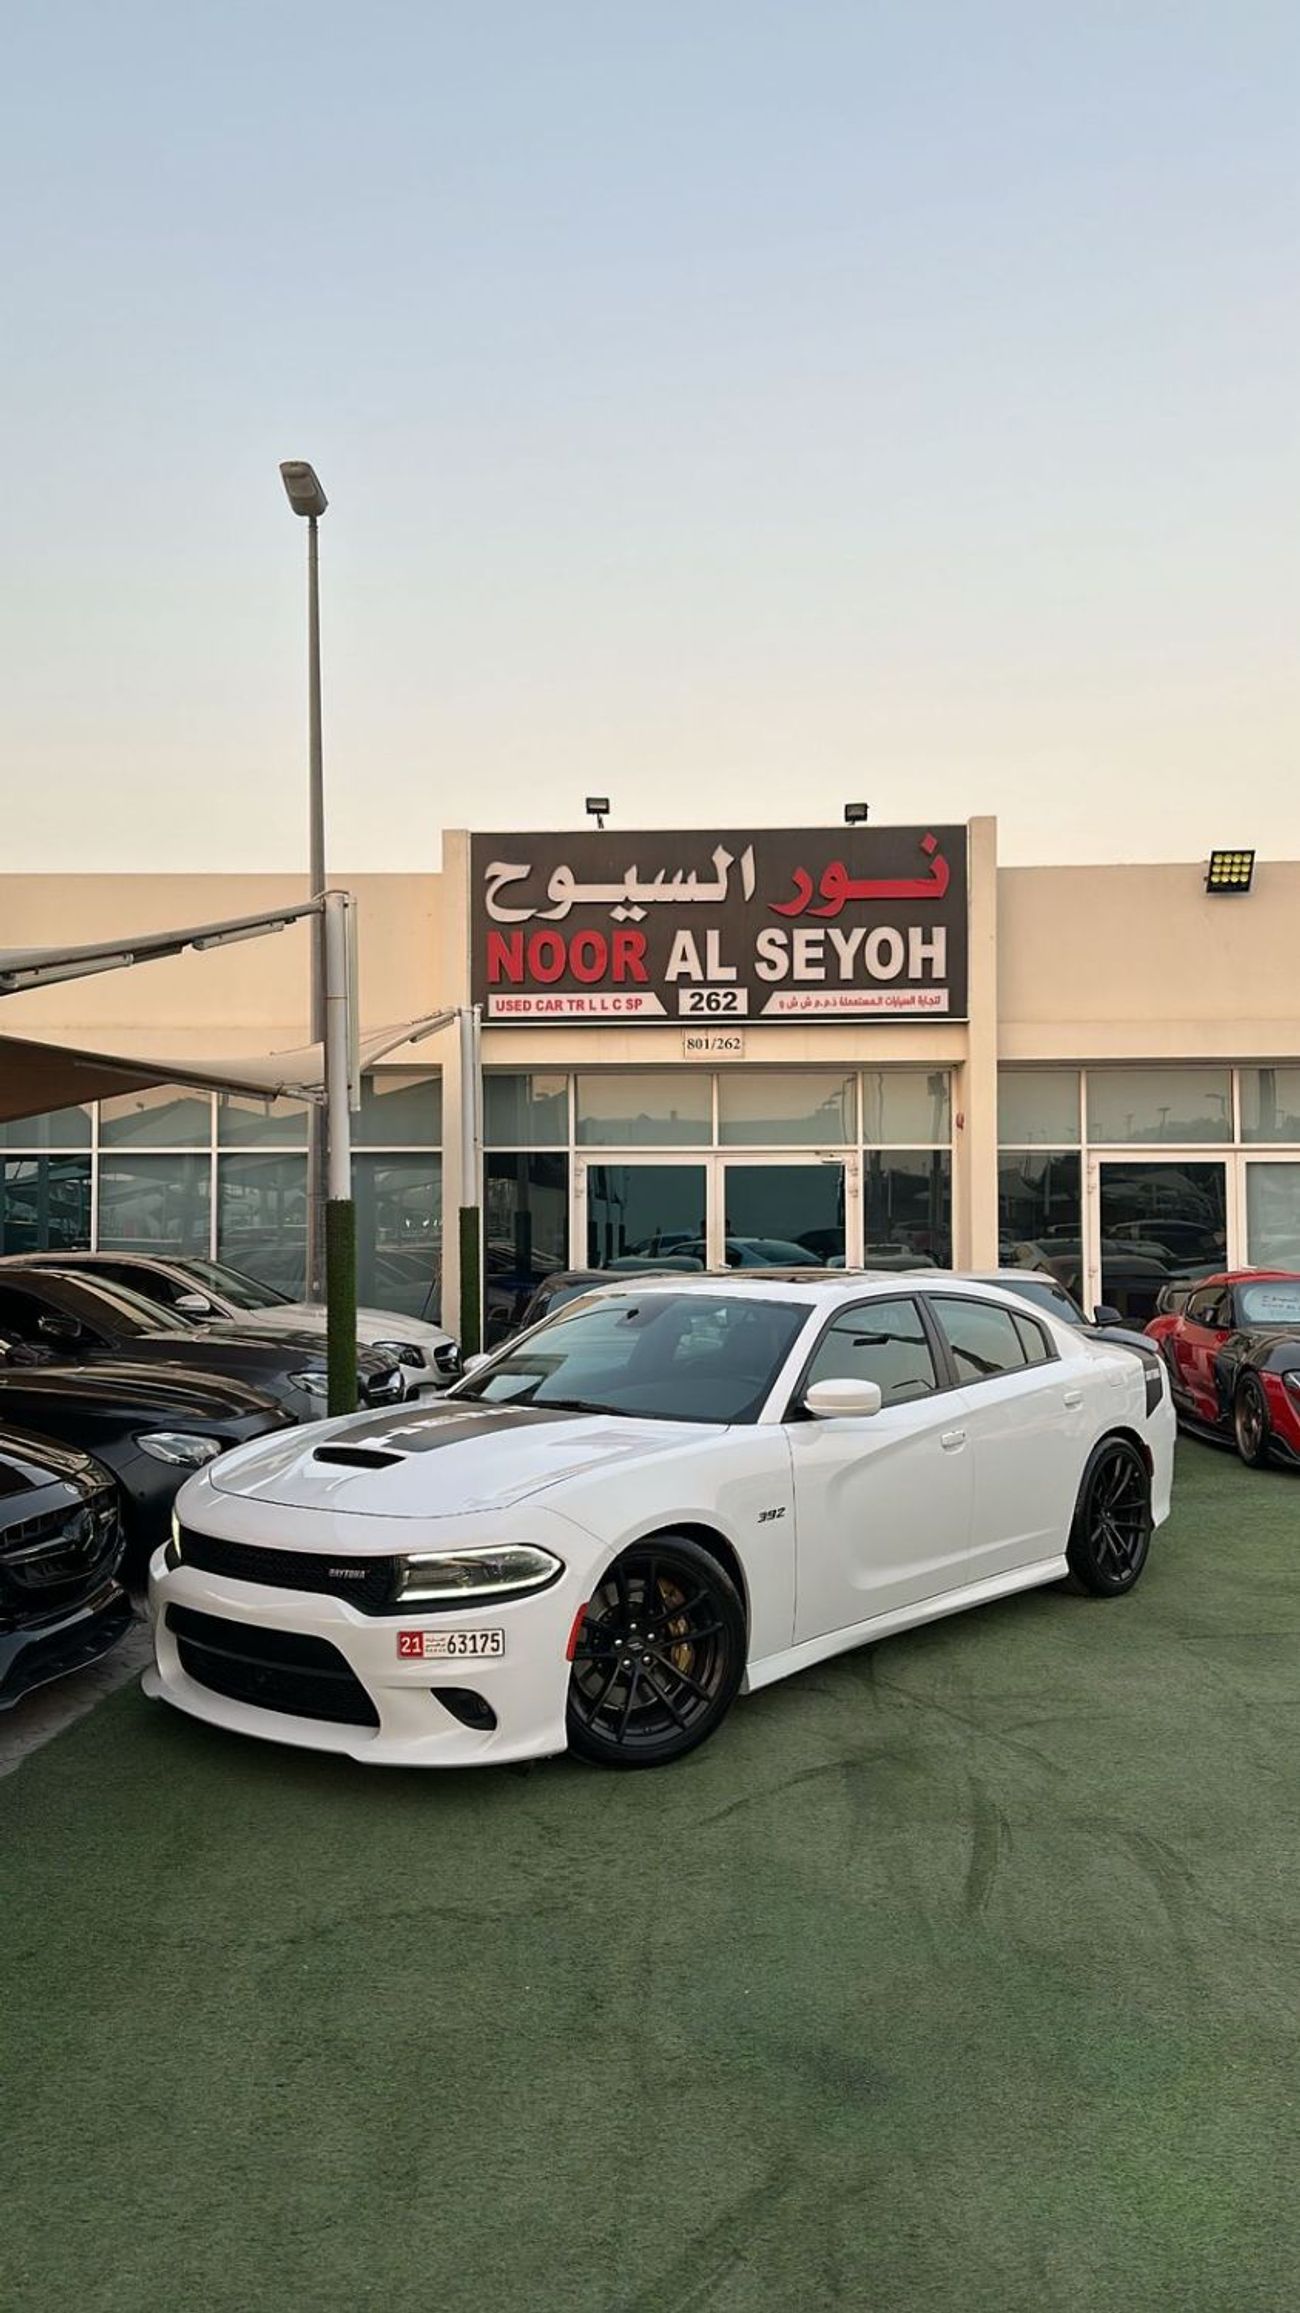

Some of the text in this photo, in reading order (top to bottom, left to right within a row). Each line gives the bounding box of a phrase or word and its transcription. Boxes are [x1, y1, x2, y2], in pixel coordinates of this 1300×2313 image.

[483, 832, 951, 922] نور السيوح
[485, 925, 947, 984] NOOR AL SEYOH
[495, 998, 643, 1012] USED CAR TR L L C SP
[689, 991, 738, 1012] 262
[839, 996, 882, 1007] المستعملة
[686, 1036, 742, 1051] 801/262
[757, 1506, 786, 1524] 392
[400, 1636, 422, 1654] 21
[446, 1632, 501, 1655] 63175
